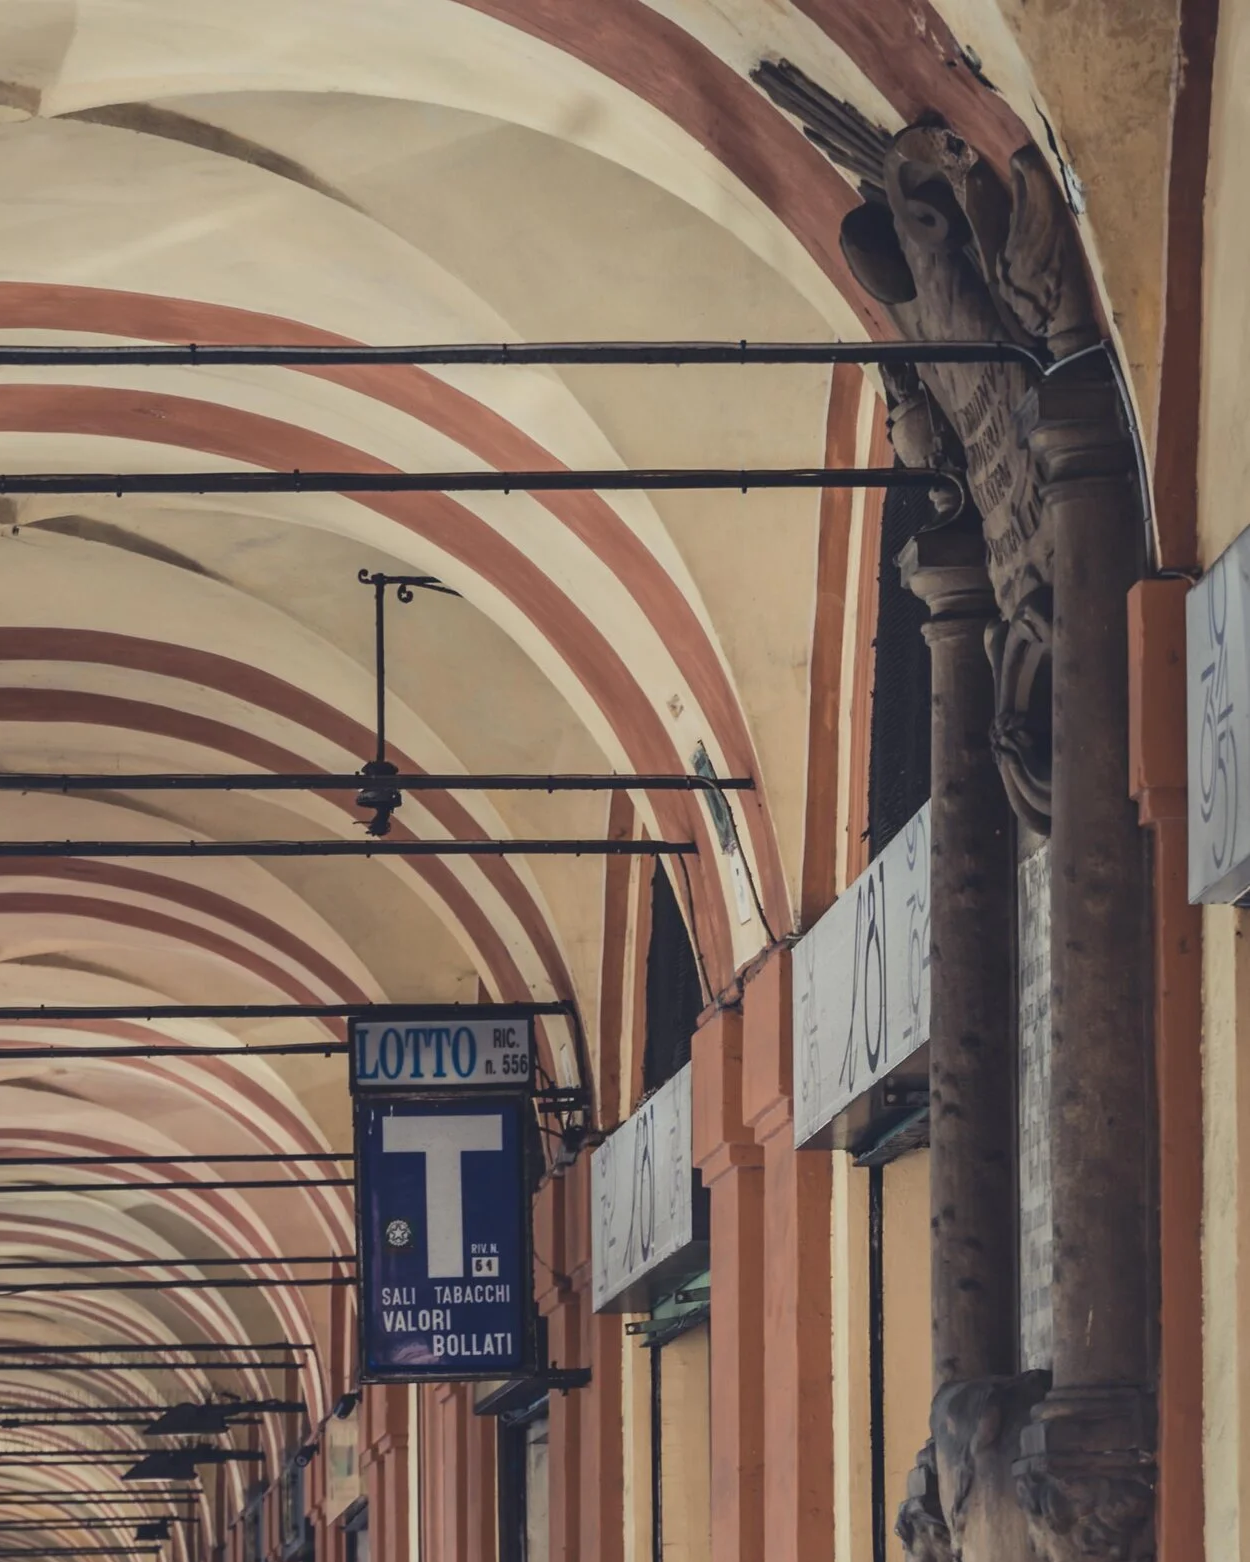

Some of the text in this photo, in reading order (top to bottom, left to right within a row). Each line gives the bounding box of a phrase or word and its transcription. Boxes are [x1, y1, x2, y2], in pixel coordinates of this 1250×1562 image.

[356, 1026, 520, 1080] LOTTO RIC.
[502, 1054, 528, 1075] 556
[382, 1114, 503, 1279] T
[381, 1284, 510, 1306] SALI TABACCHI
[383, 1309, 451, 1332] VALORI
[432, 1332, 512, 1356] BOLLATI
